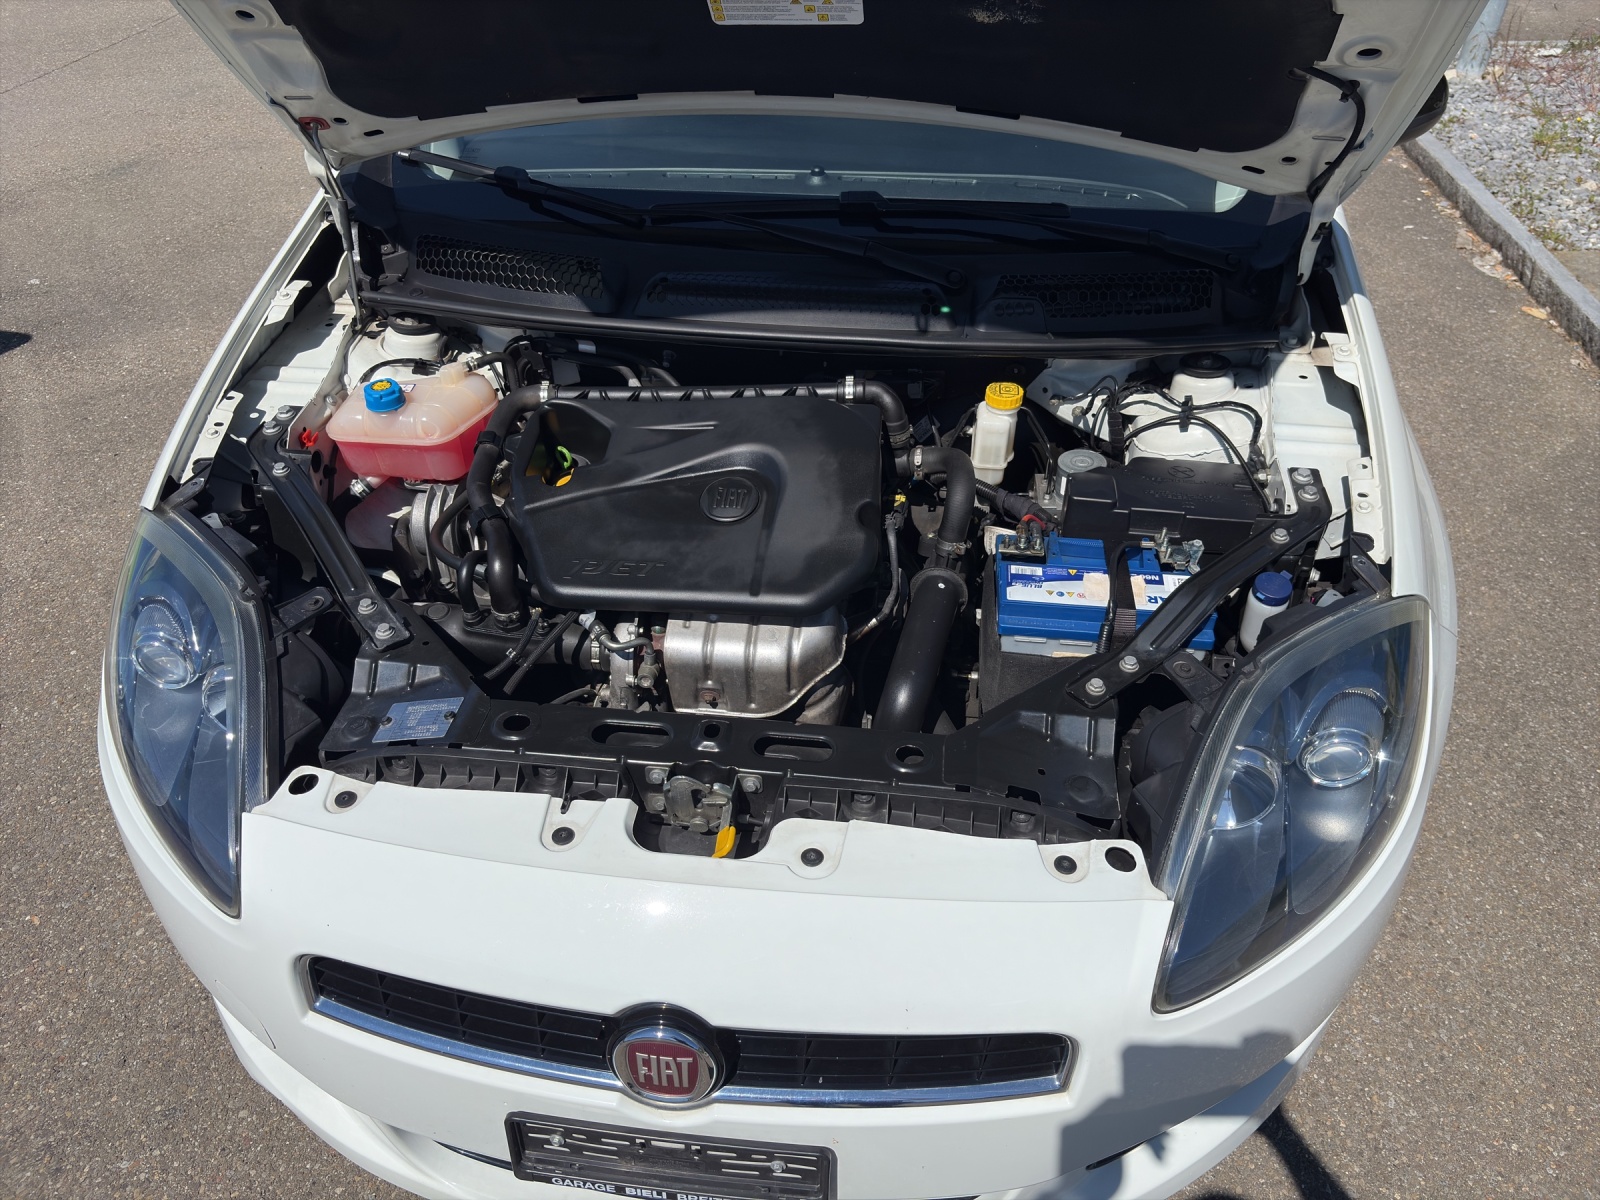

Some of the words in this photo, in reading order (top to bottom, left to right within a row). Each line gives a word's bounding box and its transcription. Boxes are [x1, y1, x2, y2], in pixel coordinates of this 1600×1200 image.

[711, 486, 748, 509] FIAT
[635, 1052, 693, 1088] FIAT
[551, 1177, 616, 1193] GARAGE
[625, 1186, 667, 1199] BIELI
